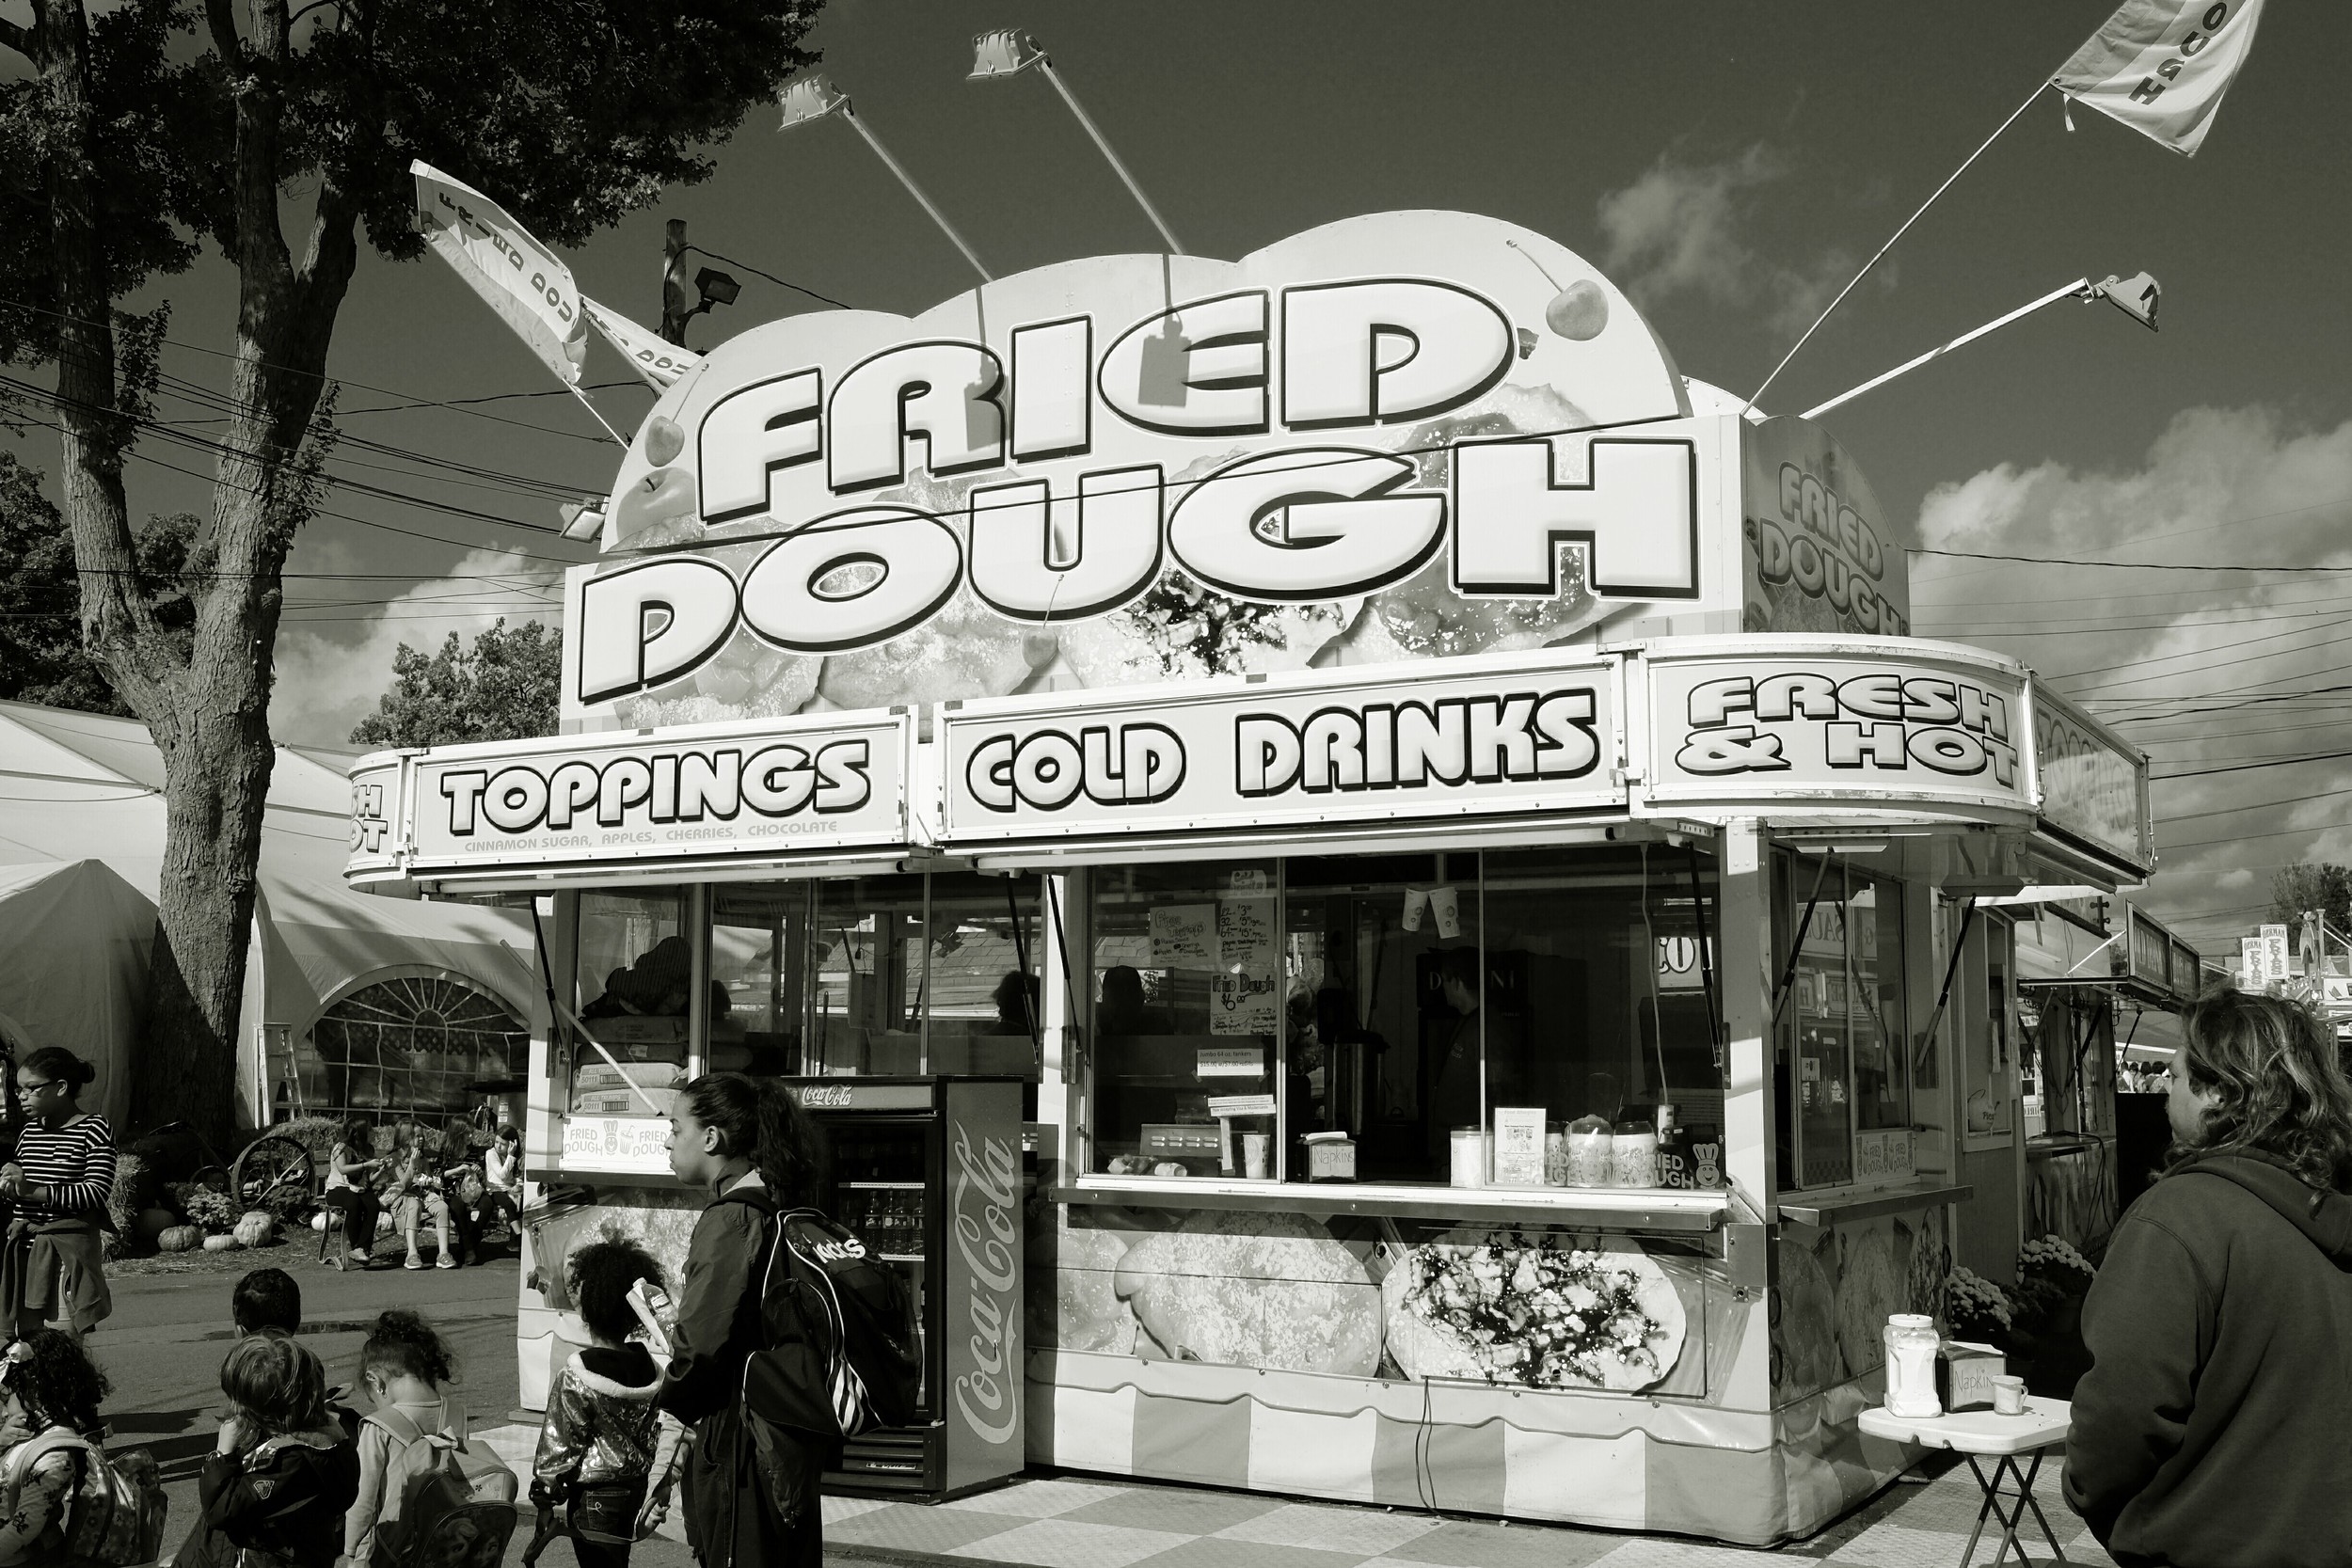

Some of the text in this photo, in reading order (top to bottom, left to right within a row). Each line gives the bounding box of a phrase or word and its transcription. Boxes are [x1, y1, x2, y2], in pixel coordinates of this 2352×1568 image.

[438, 192, 524, 272] FRIED
[531, 272, 577, 328] DOU
[697, 277, 1517, 526] FRIED
[1779, 461, 1883, 582] FRIED
[578, 437, 1700, 705] DOUGH
[1758, 518, 1901, 636] DOUGH
[966, 688, 1600, 814] COLD DRINKS
[1675, 721, 2020, 789] & HOT
[1688, 673, 2009, 743] FRESH
[440, 738, 872, 836] TOPPINGS
[465, 821, 837, 852] CINNAMON SUGAR, APPLES, CHERRIES, CHOCOLATE
[570, 1128, 667, 1143] FRIED FRIED
[802, 1085, 854, 1106] Coca-Cola
[564, 1141, 603, 1156] DOUGH
[1314, 1146, 1354, 1172] Napkins
[954, 1118, 1017, 1445] Coca-Cola
